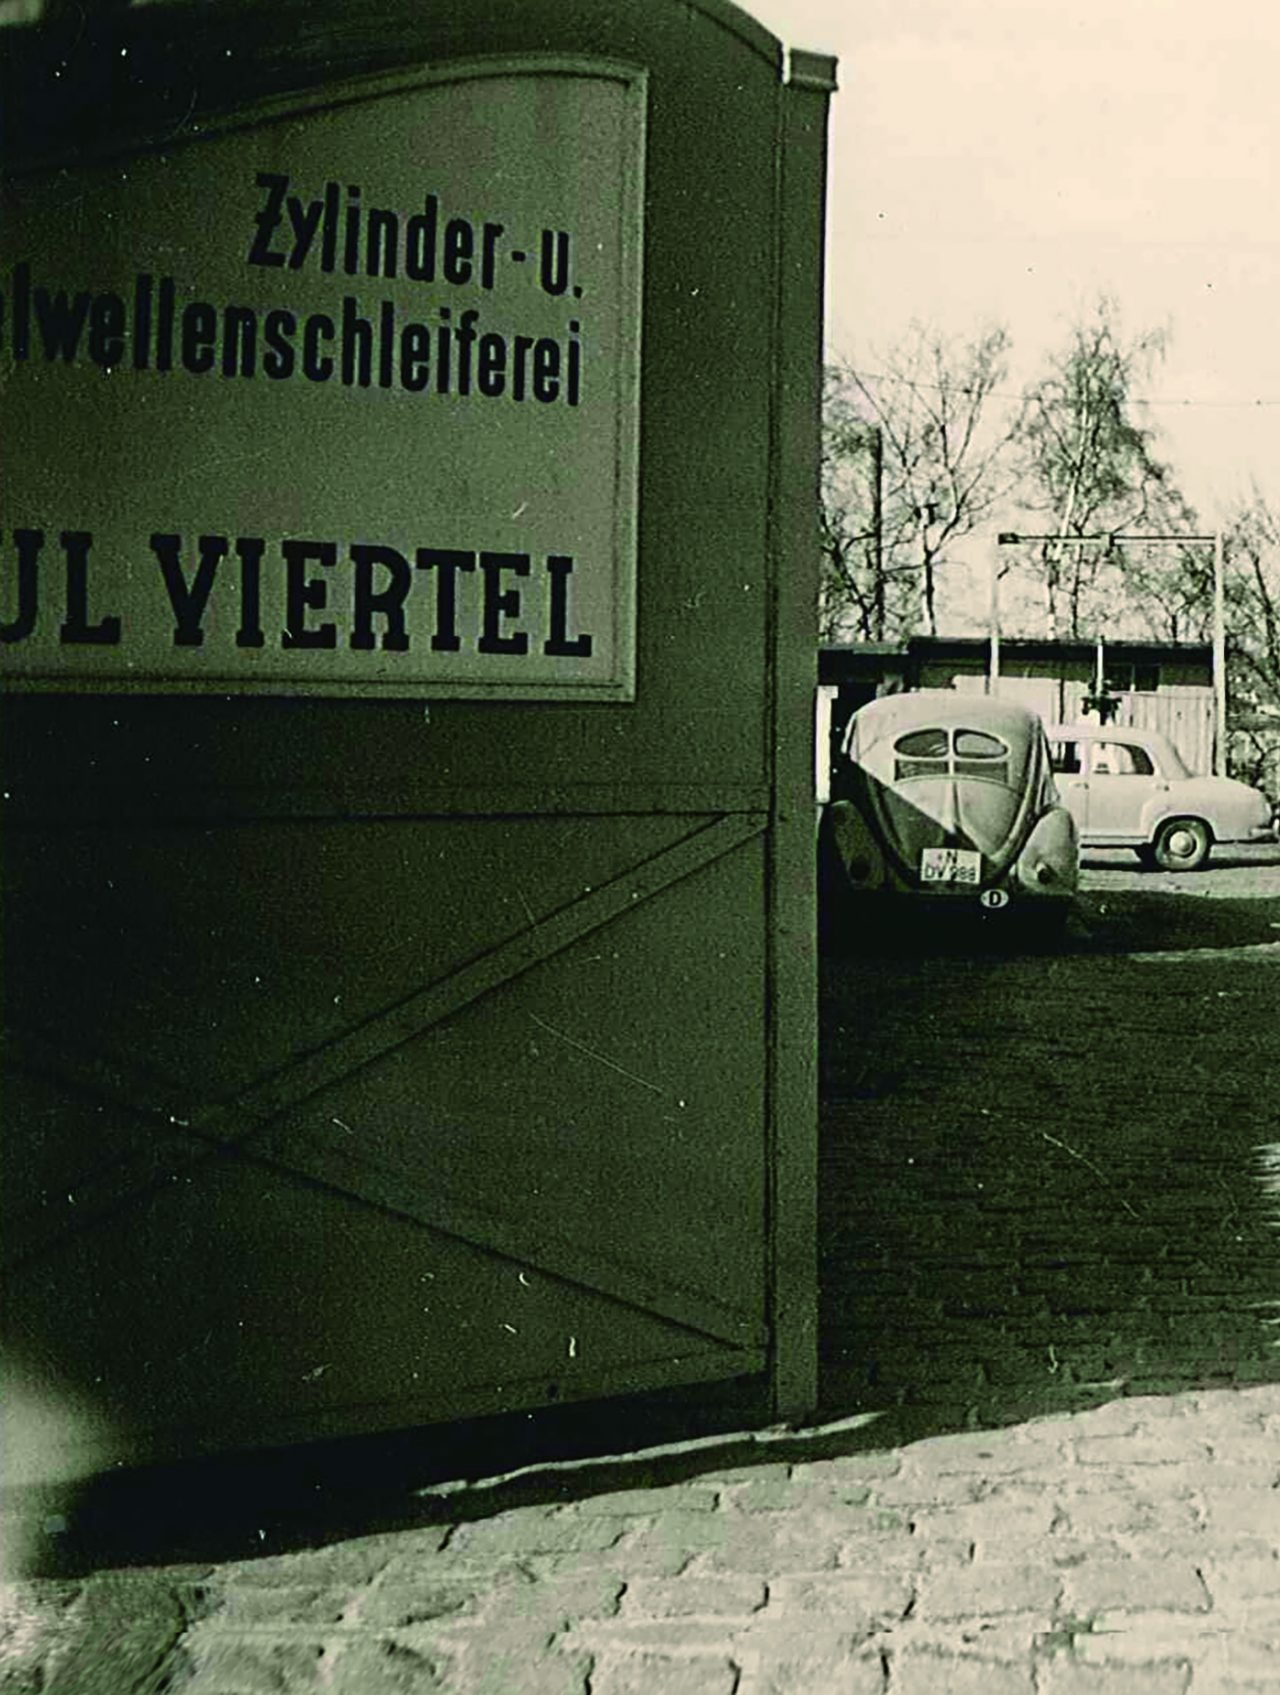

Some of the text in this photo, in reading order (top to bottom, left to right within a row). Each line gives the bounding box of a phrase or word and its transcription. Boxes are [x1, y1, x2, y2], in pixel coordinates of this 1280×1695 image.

[247, 171, 526, 291] Zylinder-
[0, 260, 580, 407] lwellenschleiferei
[149, 531, 592, 657] VIERTEL
[988, 890, 1002, 906] D
